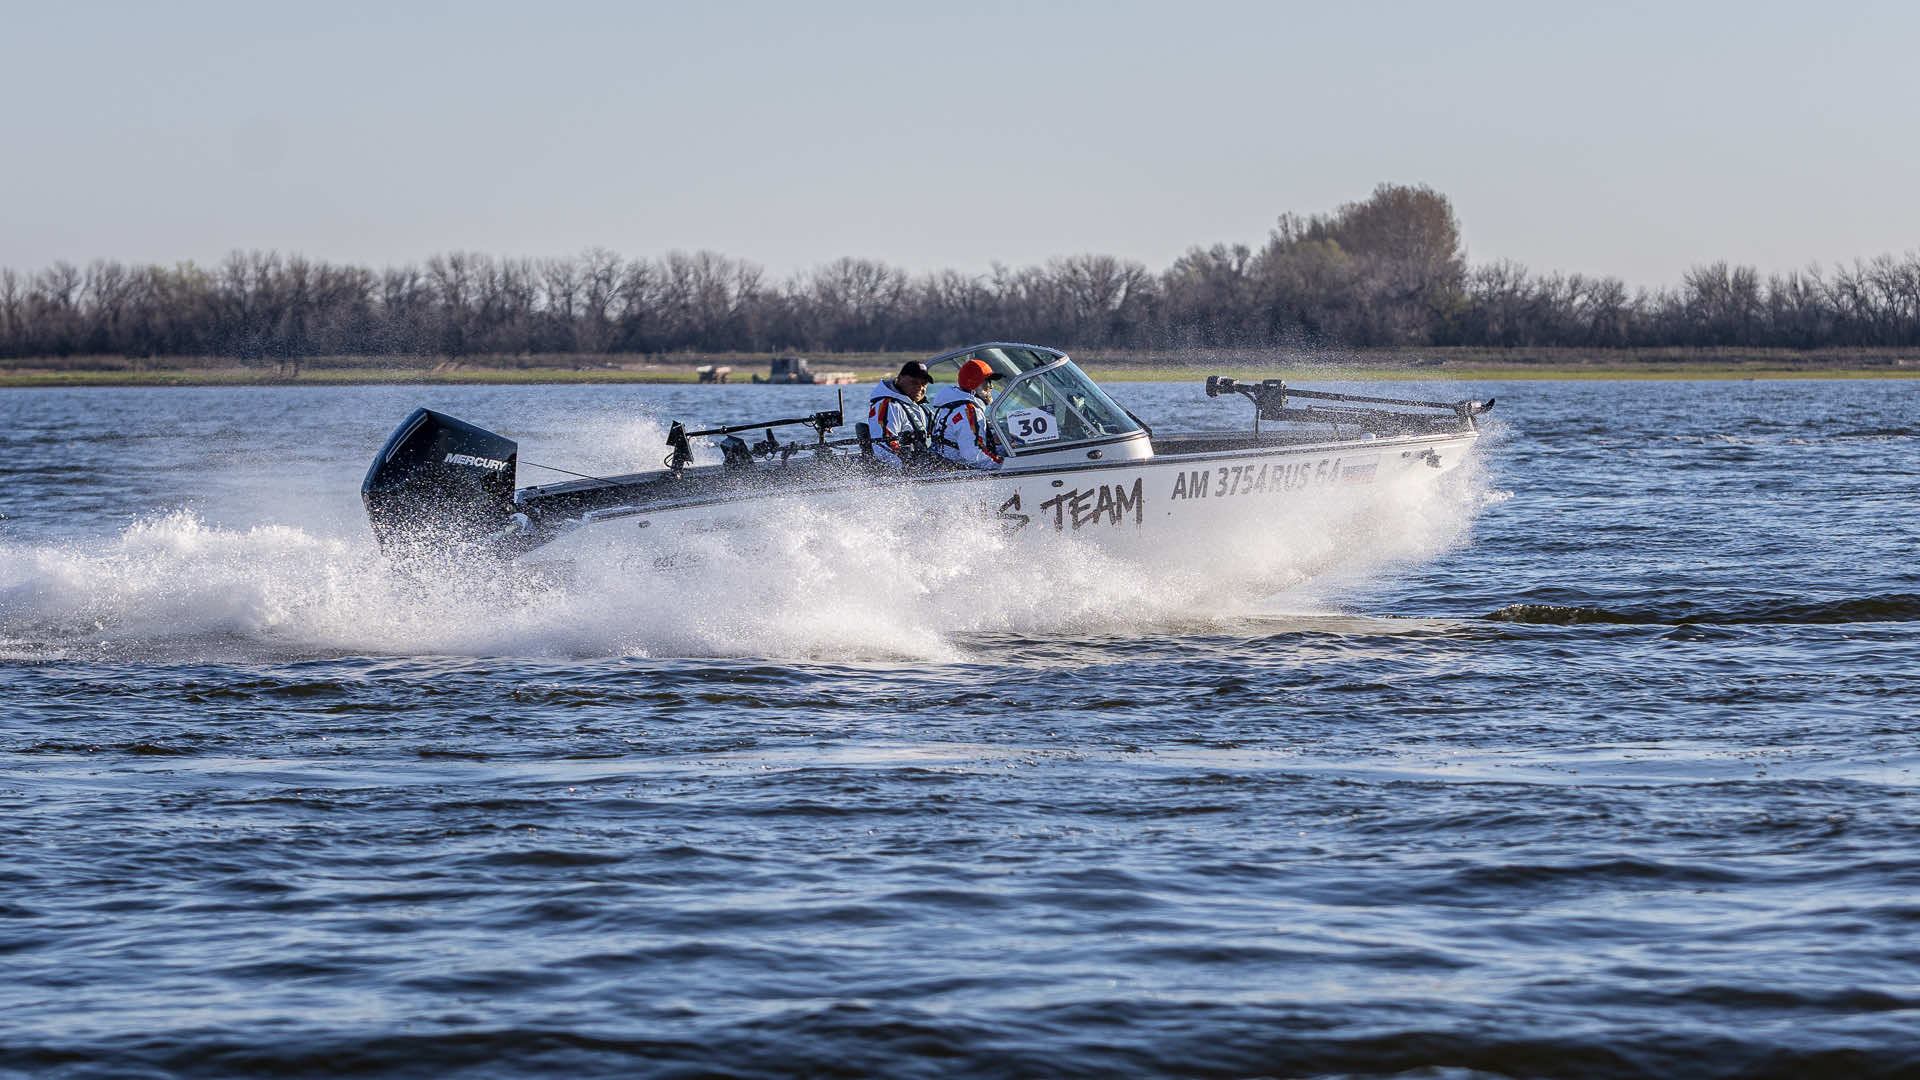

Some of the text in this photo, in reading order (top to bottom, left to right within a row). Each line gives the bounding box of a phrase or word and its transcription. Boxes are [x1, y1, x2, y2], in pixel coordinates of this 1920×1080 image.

[1018, 417, 1047, 437] 30
[444, 452, 508, 471] MERCURY
[1171, 471, 1210, 500] AM
[1040, 477, 1143, 533] TEAM
